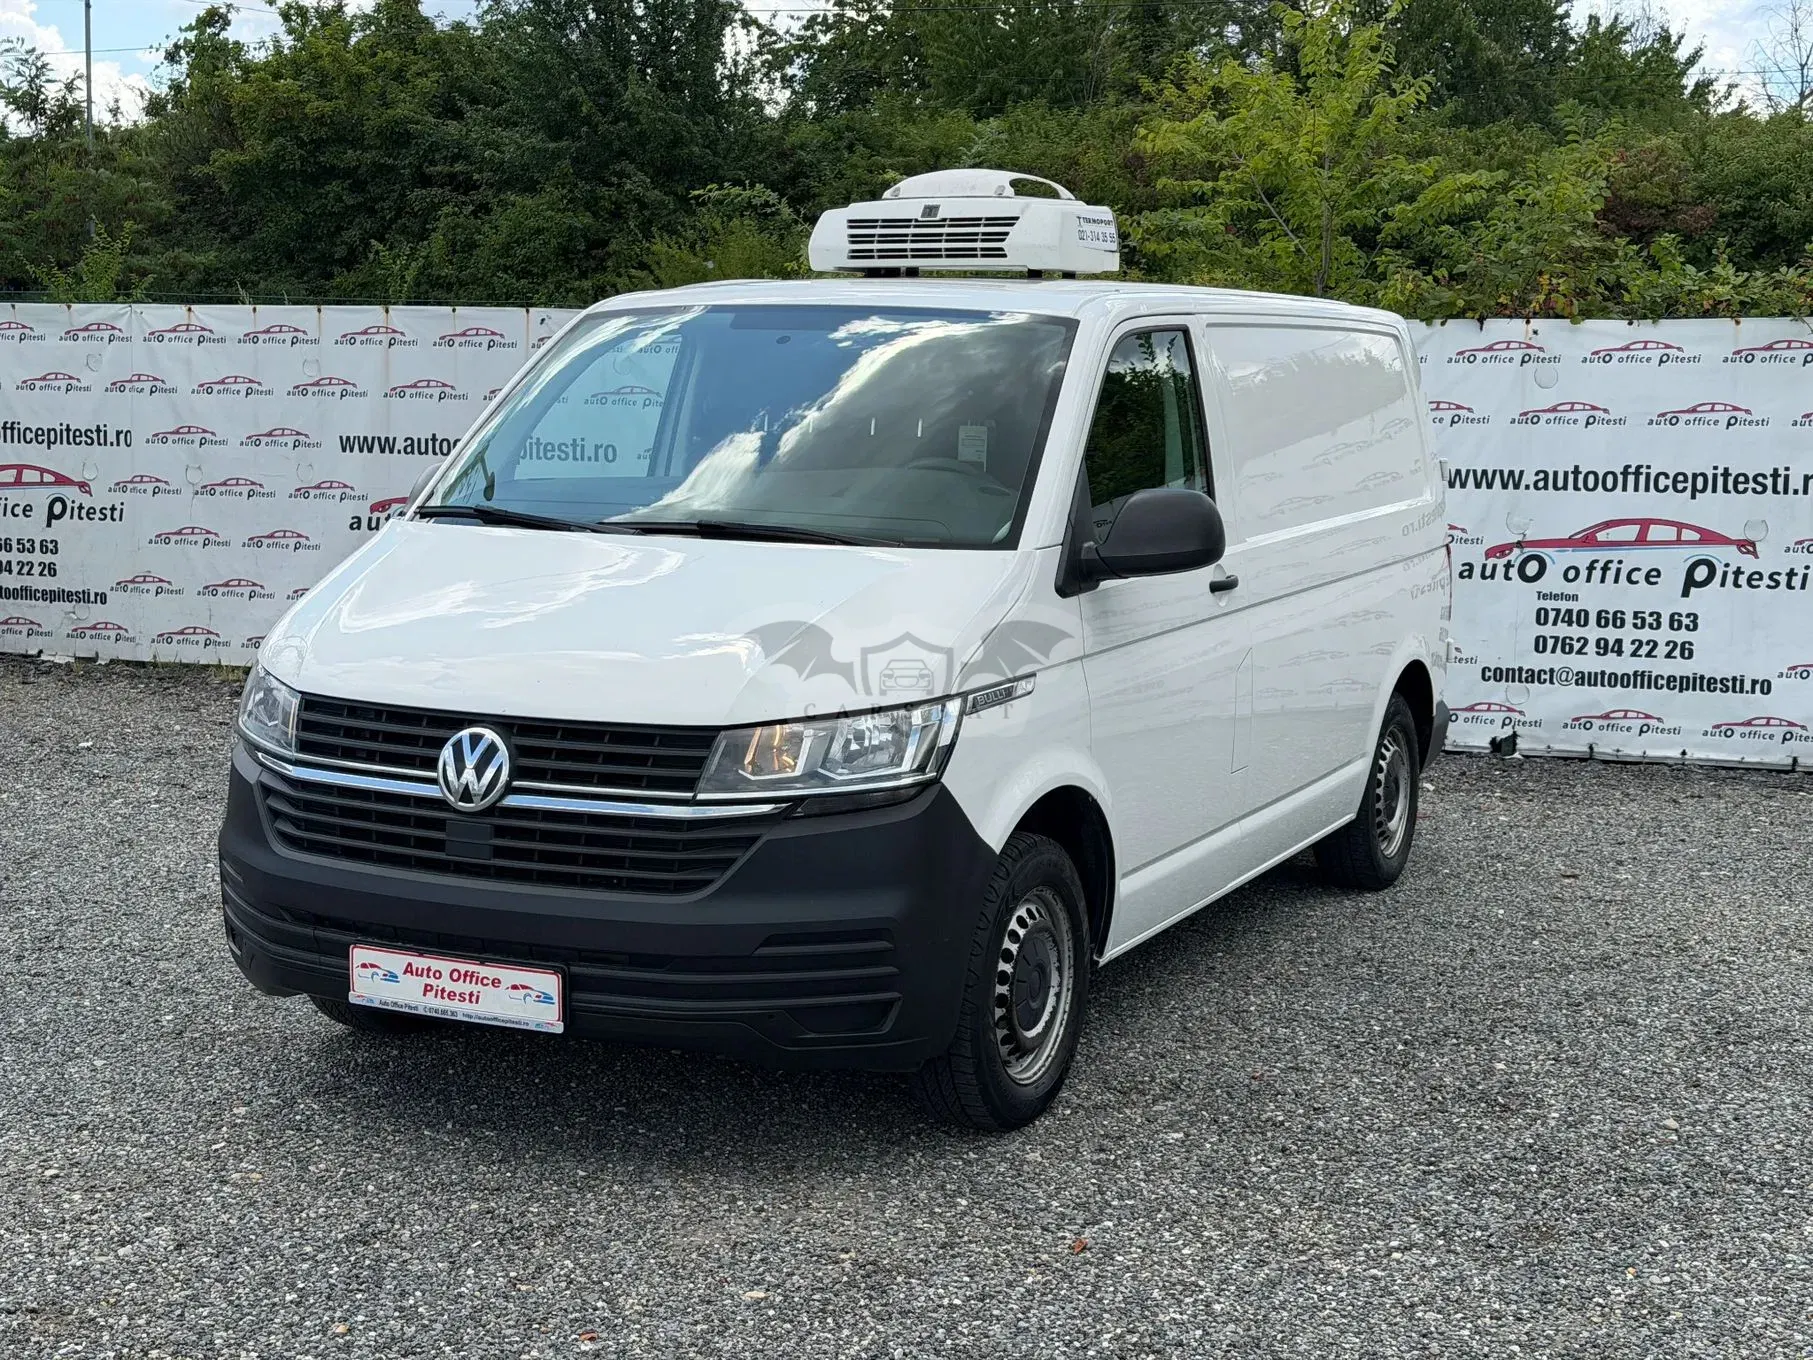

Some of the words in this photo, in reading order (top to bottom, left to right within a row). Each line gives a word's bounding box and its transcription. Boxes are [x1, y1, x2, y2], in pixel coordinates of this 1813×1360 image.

[0, 333, 15, 341] fice
[82, 334, 104, 342] office
[168, 336, 193, 344] office
[360, 338, 383, 346] office
[458, 340, 483, 348] office
[1482, 354, 1514, 364] office
[1618, 354, 1652, 364] office
[1760, 354, 1796, 364] office
[39, 384, 62, 392] office
[217, 388, 241, 396] office
[312, 389, 336, 397] office
[409, 391, 434, 400] office
[612, 398, 637, 407] office
[1545, 416, 1579, 425] office
[1684, 416, 1720, 426] office
[0, 421, 132, 450] fficepitesti.ro
[172, 437, 194, 445] office
[265, 440, 288, 448] office
[220, 489, 243, 497] office
[314, 492, 336, 500] office
[16, 538, 36, 554] 53
[40, 539, 58, 554] 63
[174, 538, 198, 546] office
[266, 542, 290, 550] office
[16, 560, 34, 576] 22
[38, 562, 57, 578] 26
[1563, 559, 1662, 586] office
[130, 586, 150, 594] office
[222, 590, 244, 598] office
[1536, 591, 1578, 602] Telefon
[1535, 607, 1590, 628] 0740
[1596, 610, 1626, 629] 66
[1632, 611, 1662, 630] 53
[1668, 612, 1699, 632] 63
[2, 628, 23, 636] office
[89, 632, 111, 641] office
[176, 638, 200, 646] office
[1534, 635, 1589, 656] 0762
[1595, 636, 1625, 657] 94
[1630, 638, 1658, 658] 22
[1664, 640, 1694, 660] 26
[1481, 666, 1772, 696] contact@autoofficepitesti.ro
[1464, 716, 1496, 726] office
[1598, 722, 1632, 733] office
[1740, 730, 1775, 740] office
[402, 962, 443, 980] Auto
[449, 968, 502, 988] Office
[422, 983, 481, 1004] Pitesti
